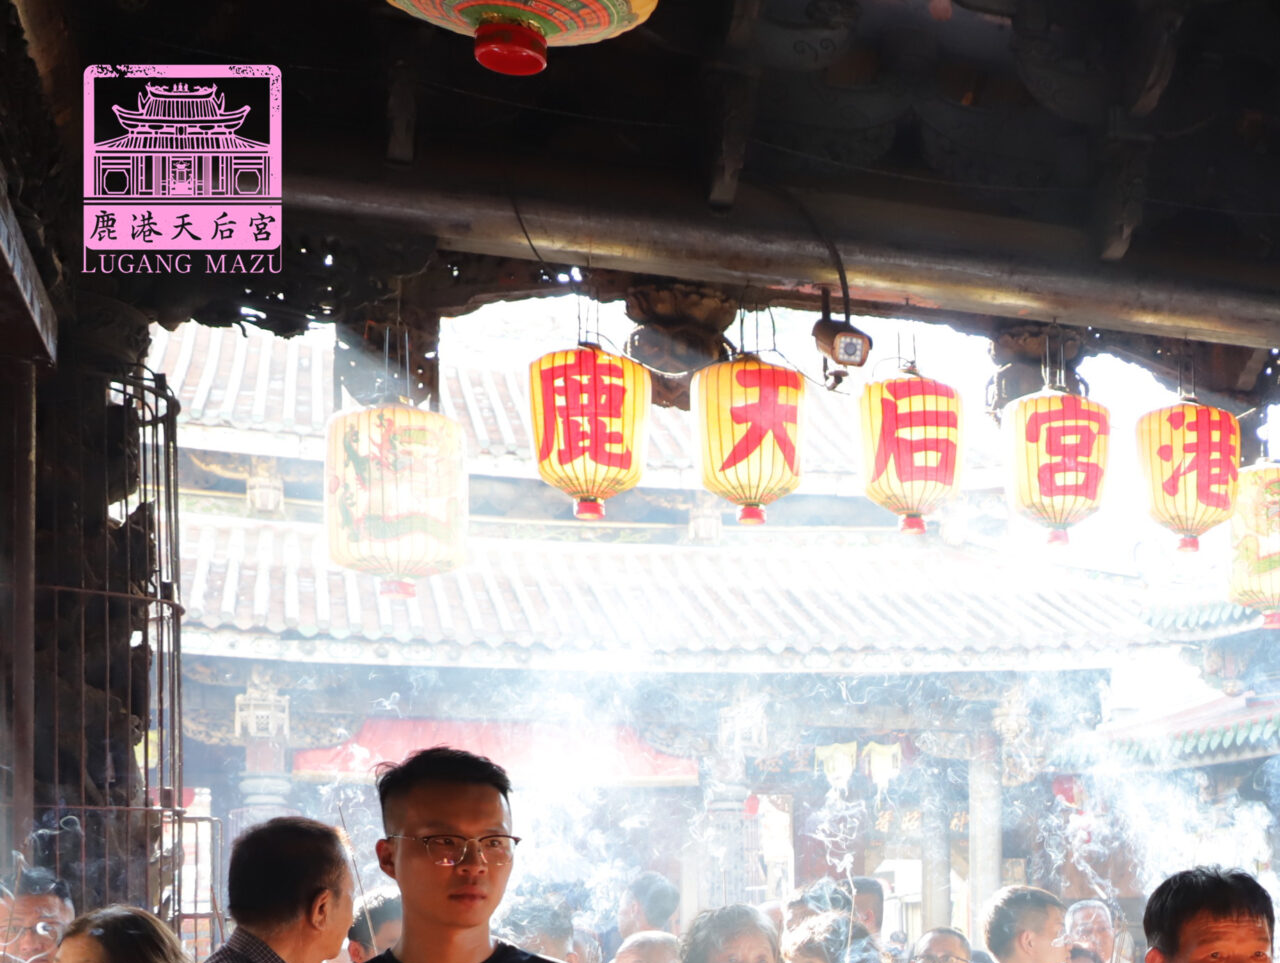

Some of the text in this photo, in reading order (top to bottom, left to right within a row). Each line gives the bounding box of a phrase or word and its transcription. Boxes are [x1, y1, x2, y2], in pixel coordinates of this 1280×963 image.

[539, 351, 632, 470] 鹿
[719, 368, 802, 477] 天
[872, 379, 958, 486] 后
[1025, 394, 1110, 501] 宮
[1156, 405, 1239, 511] 港
